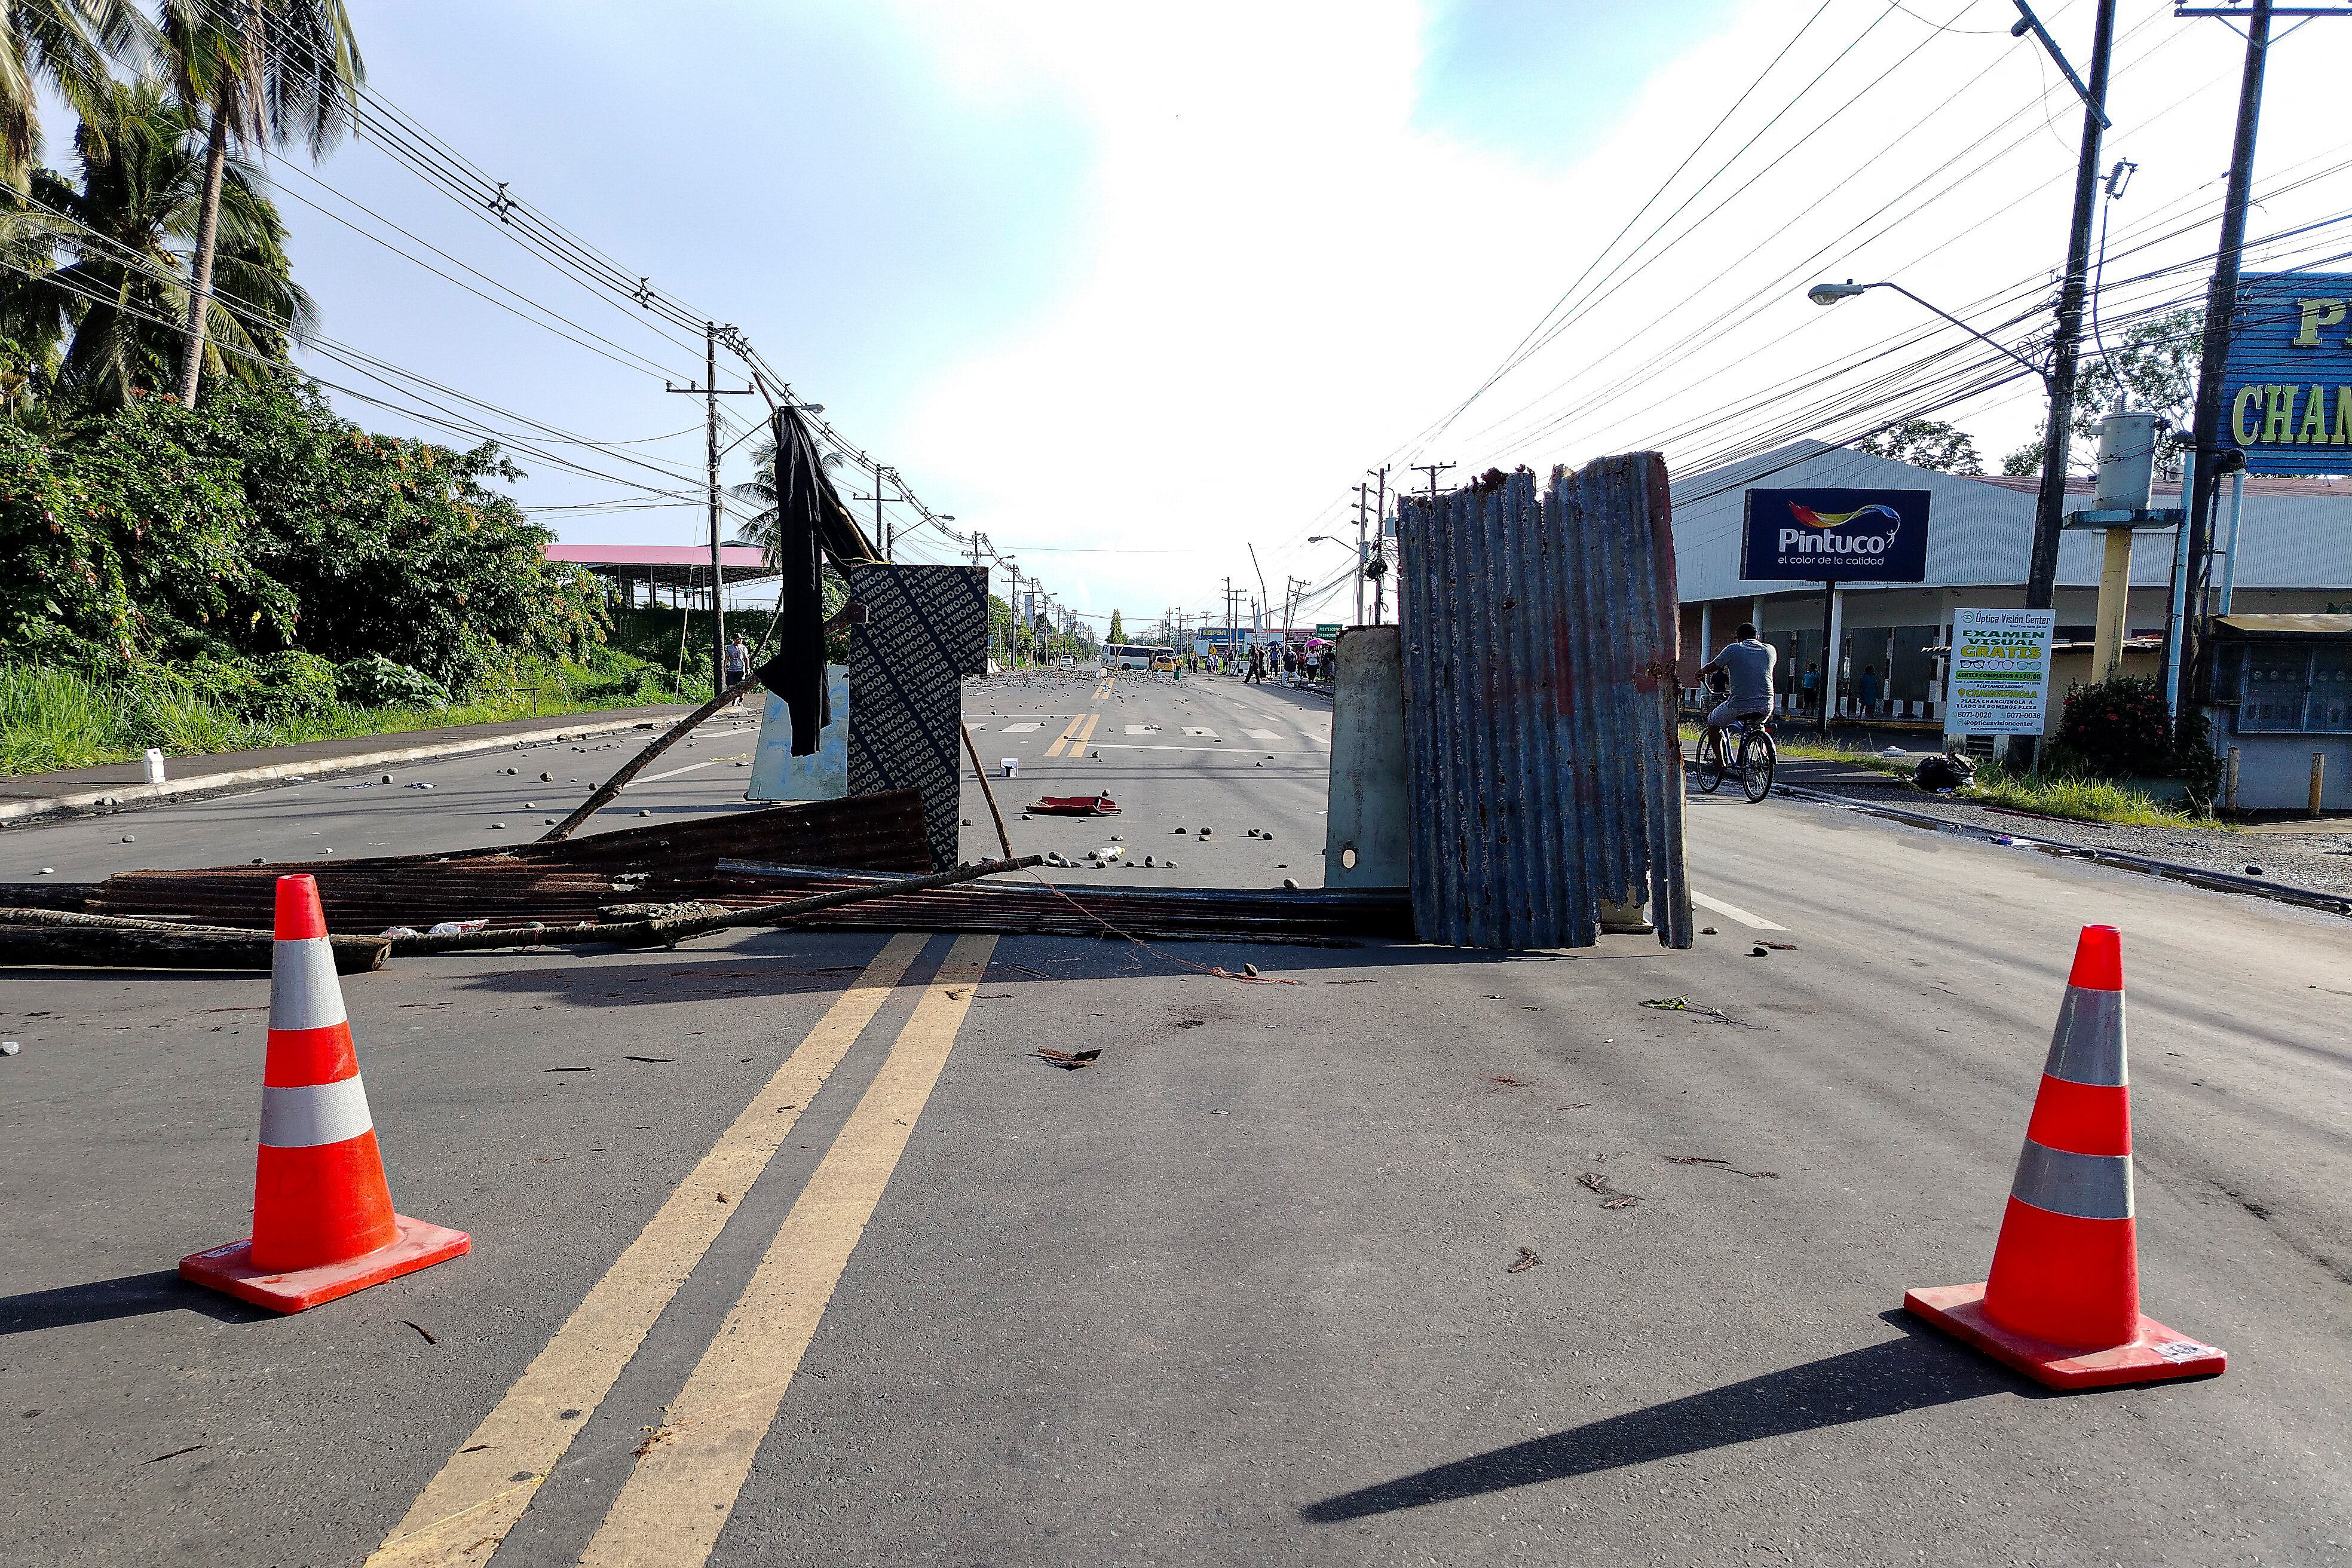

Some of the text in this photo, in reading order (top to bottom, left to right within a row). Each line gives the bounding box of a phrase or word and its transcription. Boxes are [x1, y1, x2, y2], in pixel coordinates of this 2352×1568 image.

[2293, 298, 2352, 345] P
[1778, 528, 1885, 554] Pintuco
[1778, 555, 1885, 565] el color de la calidad
[867, 605, 912, 638] PLYWOOD
[916, 574, 961, 606] PLYWOOD
[872, 614, 918, 647] PLYWOOD
[922, 583, 967, 615] PLYWOOD
[1976, 611, 2051, 625] Óptica Visión Center
[878, 624, 924, 656] PLYWOOD
[928, 592, 973, 624] PLYWOOD
[884, 633, 930, 666] PLYWOOD
[934, 601, 979, 633] PLYWOOD
[1962, 630, 2045, 639] EXAMEN
[890, 642, 936, 675] PLYWOOD
[940, 611, 985, 643] PLYWOOD
[1961, 645, 2041, 659] GRATIS
[1967, 638, 2037, 646] VISUAL
[896, 651, 942, 684] PLYWOOD
[902, 661, 948, 693] PLYWOOD
[859, 702, 905, 734] PLYWOOD
[908, 670, 954, 702] PLYWOOD
[1965, 688, 2038, 699] CHANGUINOLA
[865, 711, 911, 743] PLYWOOD
[914, 679, 960, 712] PLYWOOD
[871, 720, 917, 752] PLYWOOD
[877, 729, 923, 762] PLYWOOD
[883, 739, 929, 771] PLYWOOD
[889, 748, 935, 780] PLYWOOD
[895, 757, 941, 789] PLYWOOD
